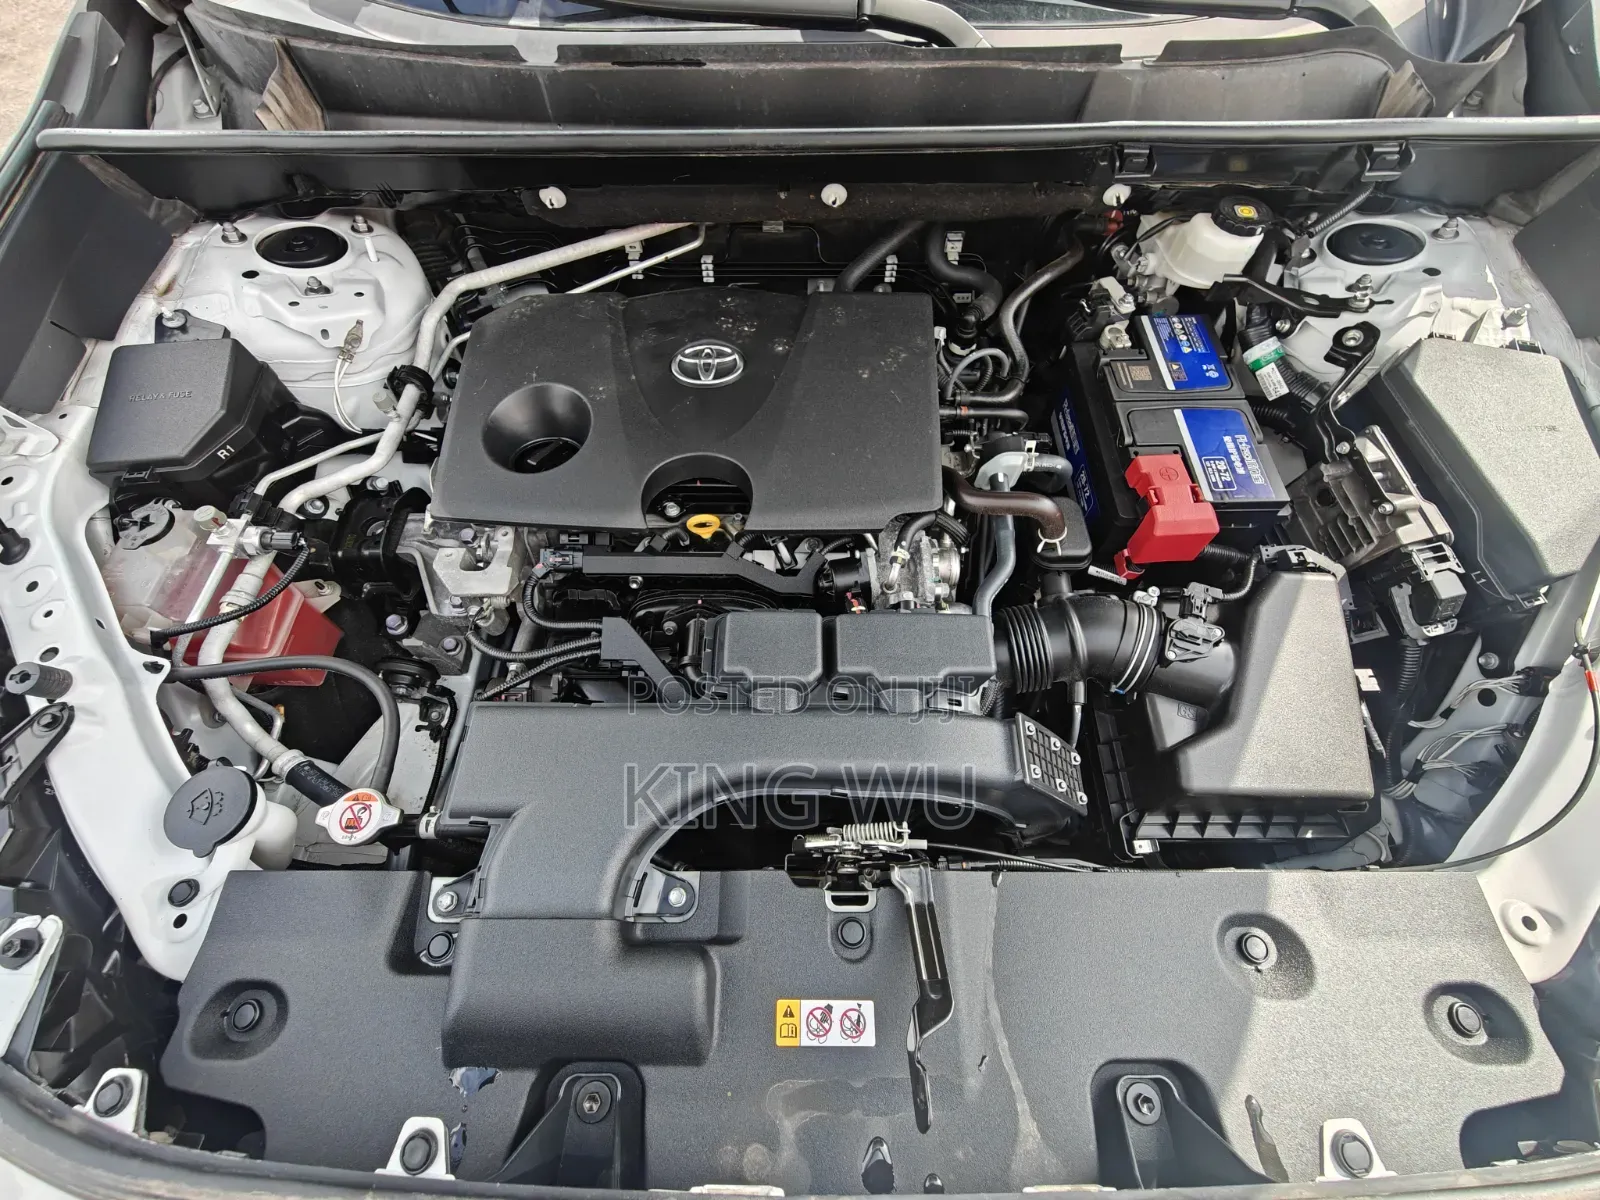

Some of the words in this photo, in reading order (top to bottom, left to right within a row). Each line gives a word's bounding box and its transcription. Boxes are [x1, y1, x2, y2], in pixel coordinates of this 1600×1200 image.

[128, 393, 160, 402] RELAY
[168, 390, 193, 398] FUSE
[216, 444, 236, 460] R1
[1215, 460, 1232, 482] 20-72
[1470, 570, 1487, 585] L1
